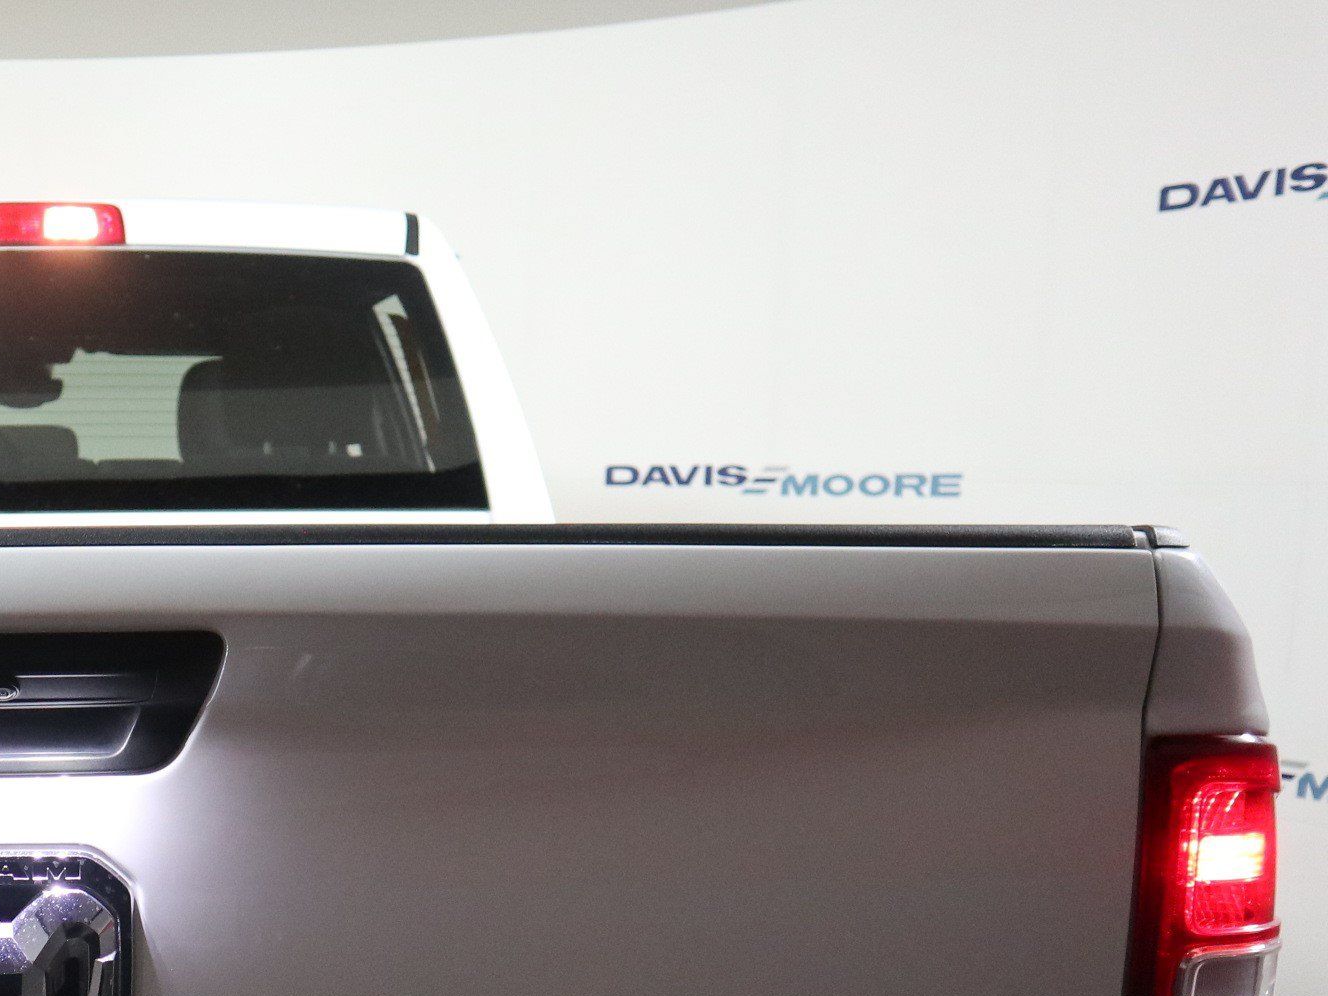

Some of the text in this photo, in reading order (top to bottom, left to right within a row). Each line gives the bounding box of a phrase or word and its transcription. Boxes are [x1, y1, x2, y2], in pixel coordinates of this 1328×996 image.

[1159, 162, 1328, 212] DAVIS
[605, 464, 963, 499] DAVIS MOORE
